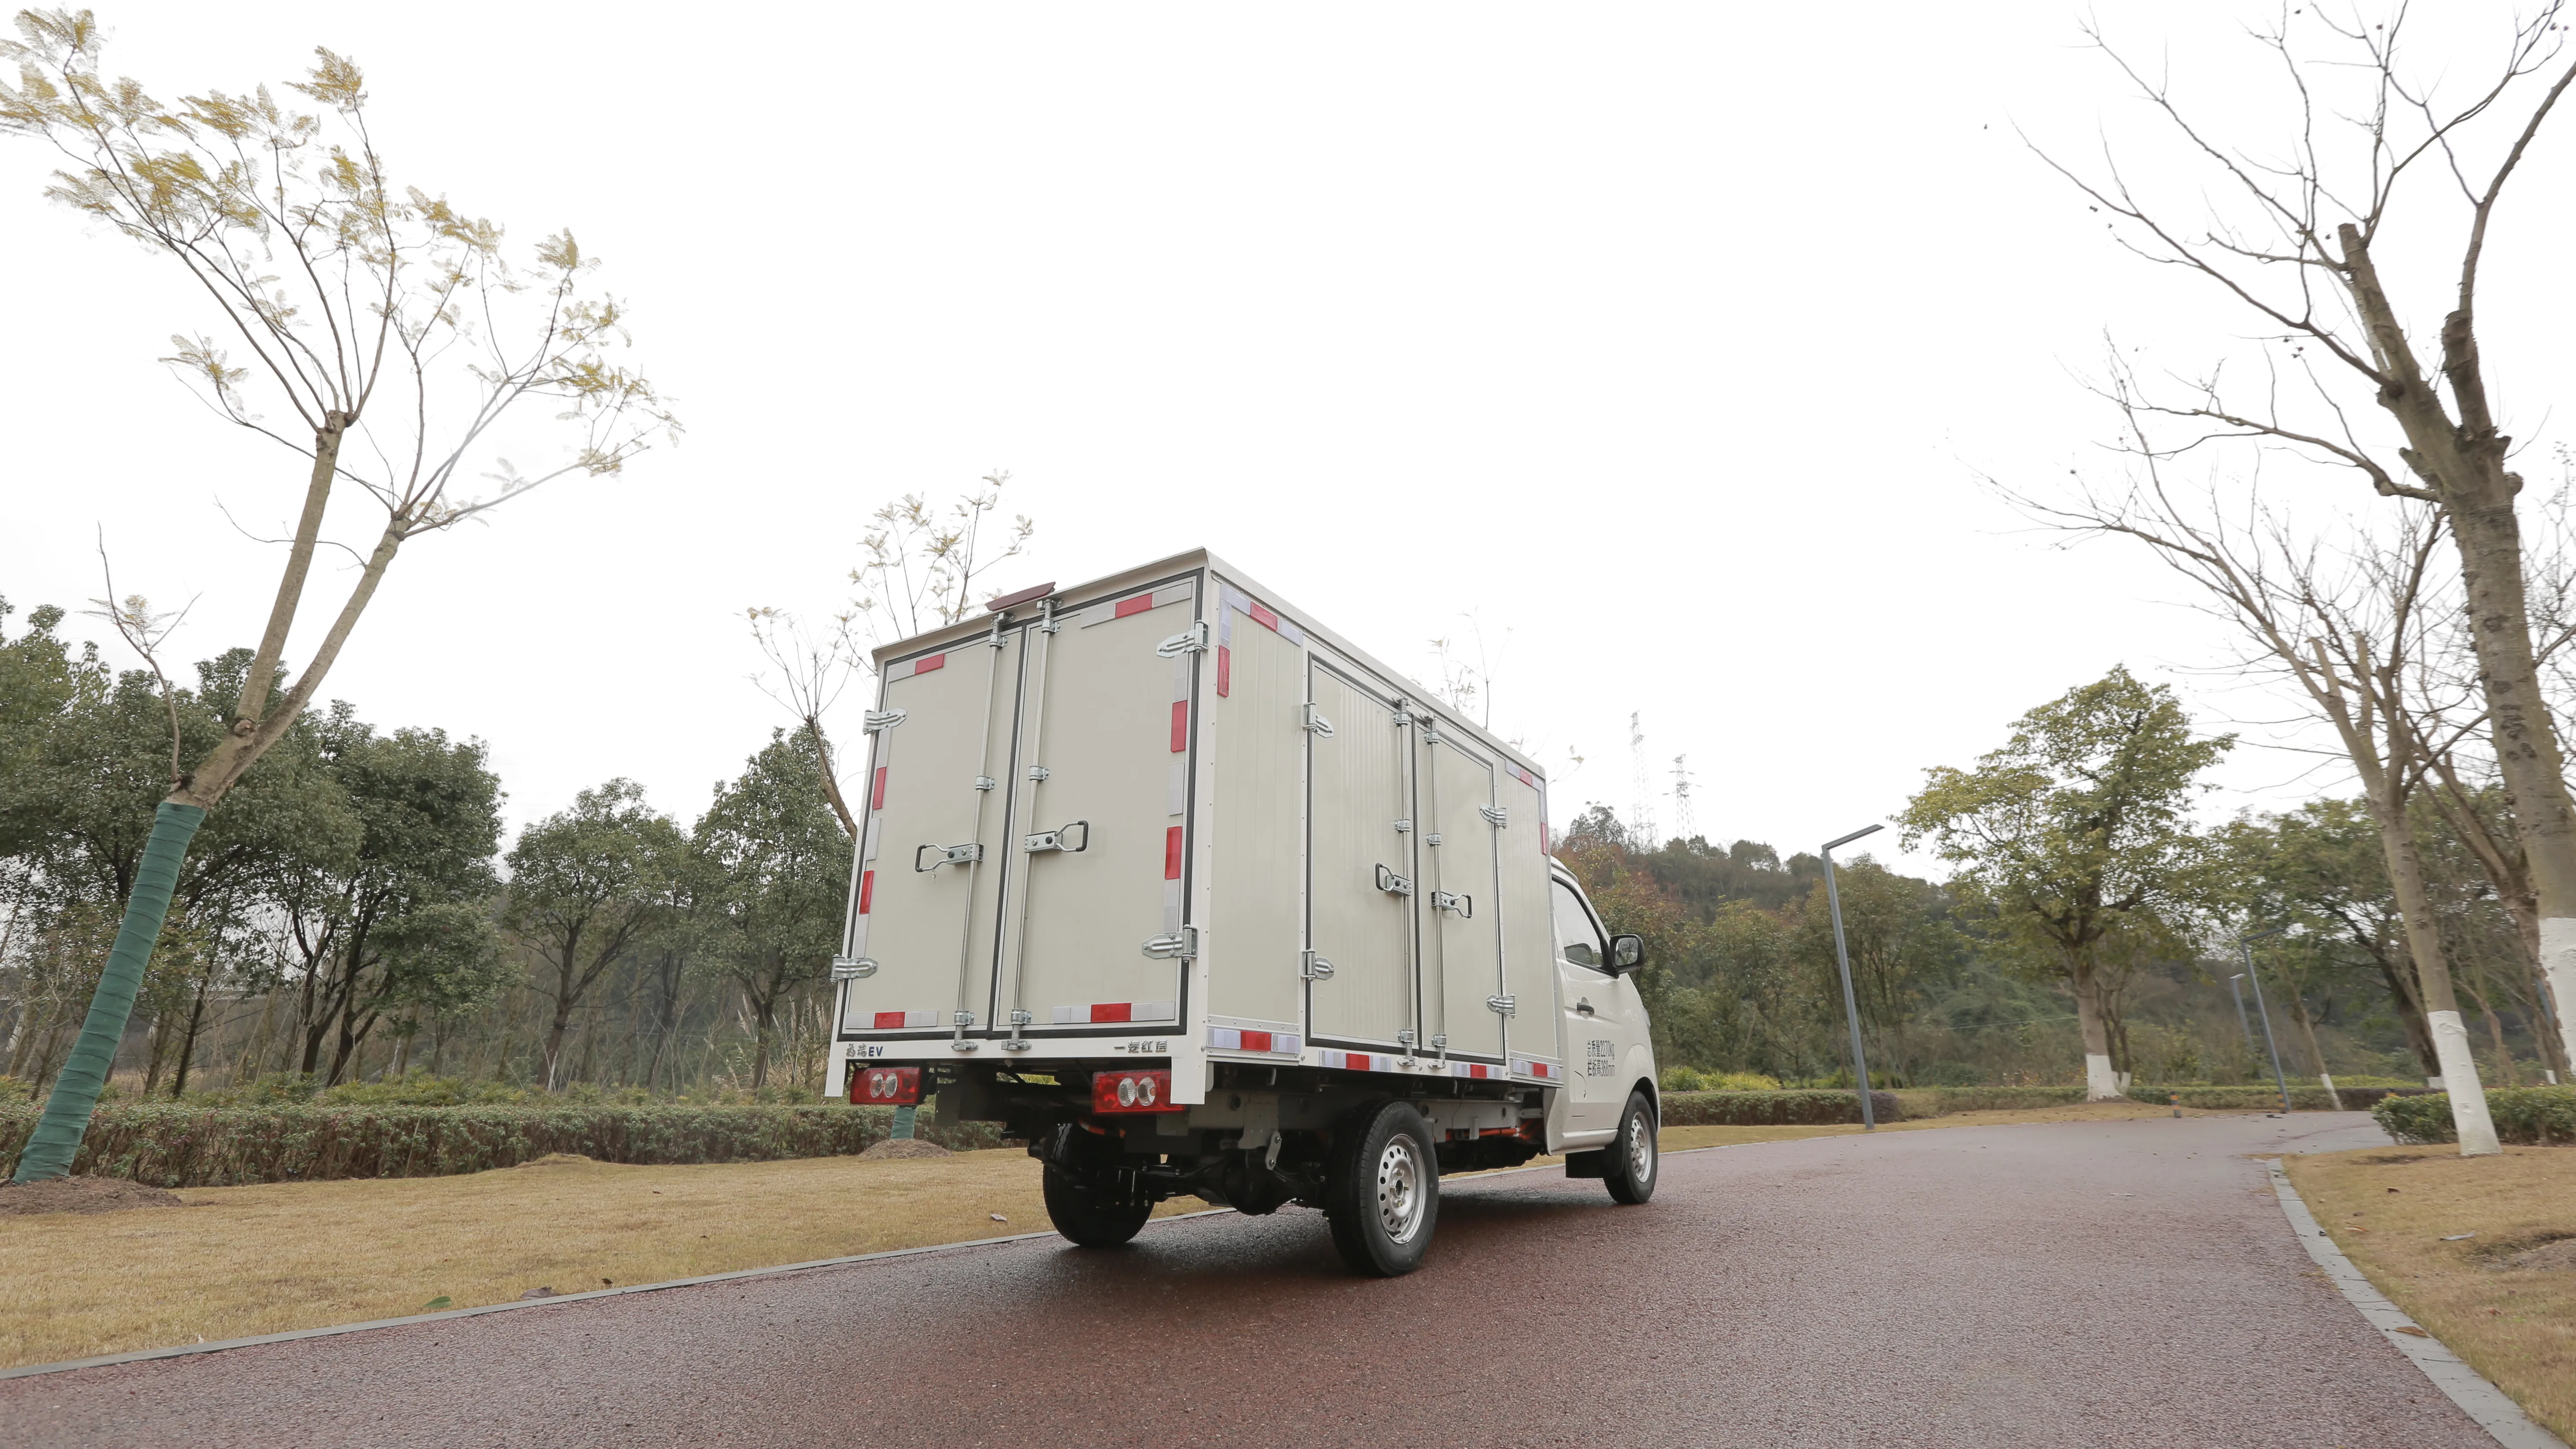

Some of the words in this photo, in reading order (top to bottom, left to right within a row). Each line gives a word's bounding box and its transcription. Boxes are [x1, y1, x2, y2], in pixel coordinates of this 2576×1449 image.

[1114, 1039, 1167, 1053] 一汽红塔
[1587, 1040, 1615, 1060] 总质量2270kg
